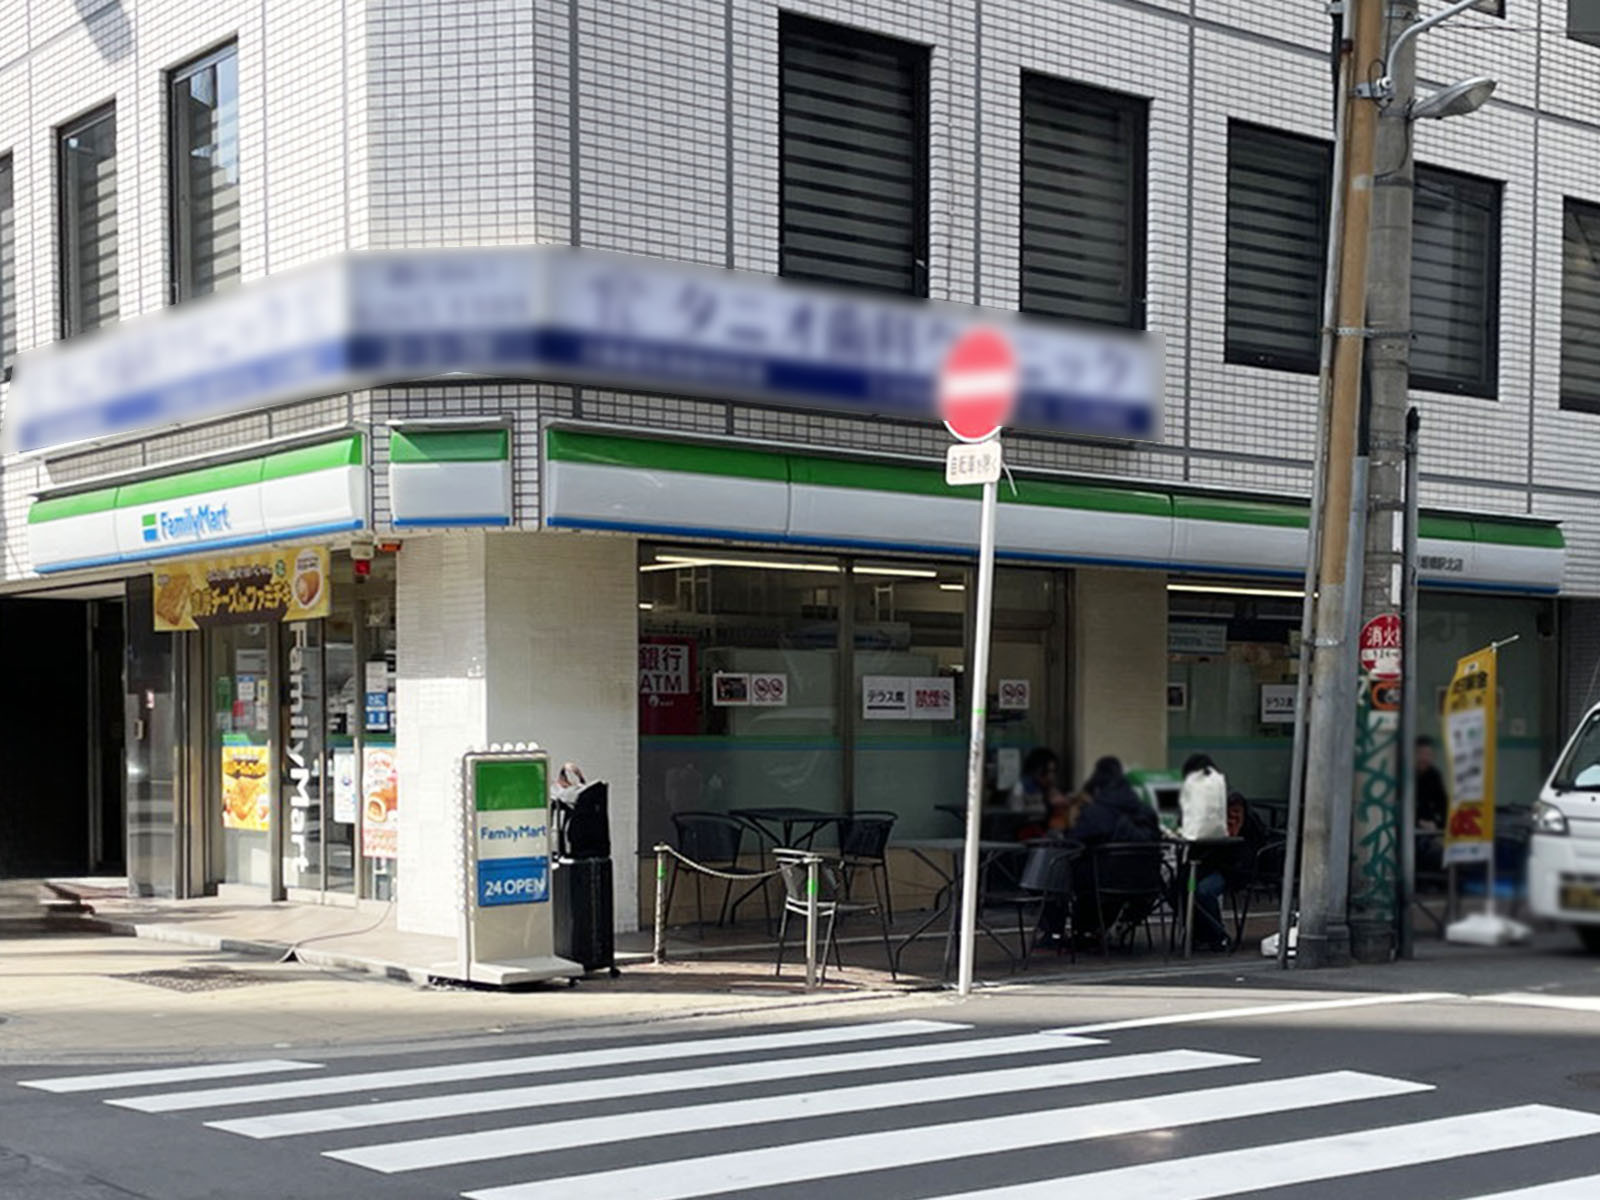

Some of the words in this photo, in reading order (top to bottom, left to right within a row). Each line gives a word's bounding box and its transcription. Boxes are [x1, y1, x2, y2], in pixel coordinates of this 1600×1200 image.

[160, 503, 231, 540] FamilyMart
[640, 674, 682, 692] ATM
[287, 622, 309, 874] FamilyMart
[480, 825, 547, 842] FamilyMart
[504, 876, 546, 895] OPEN
